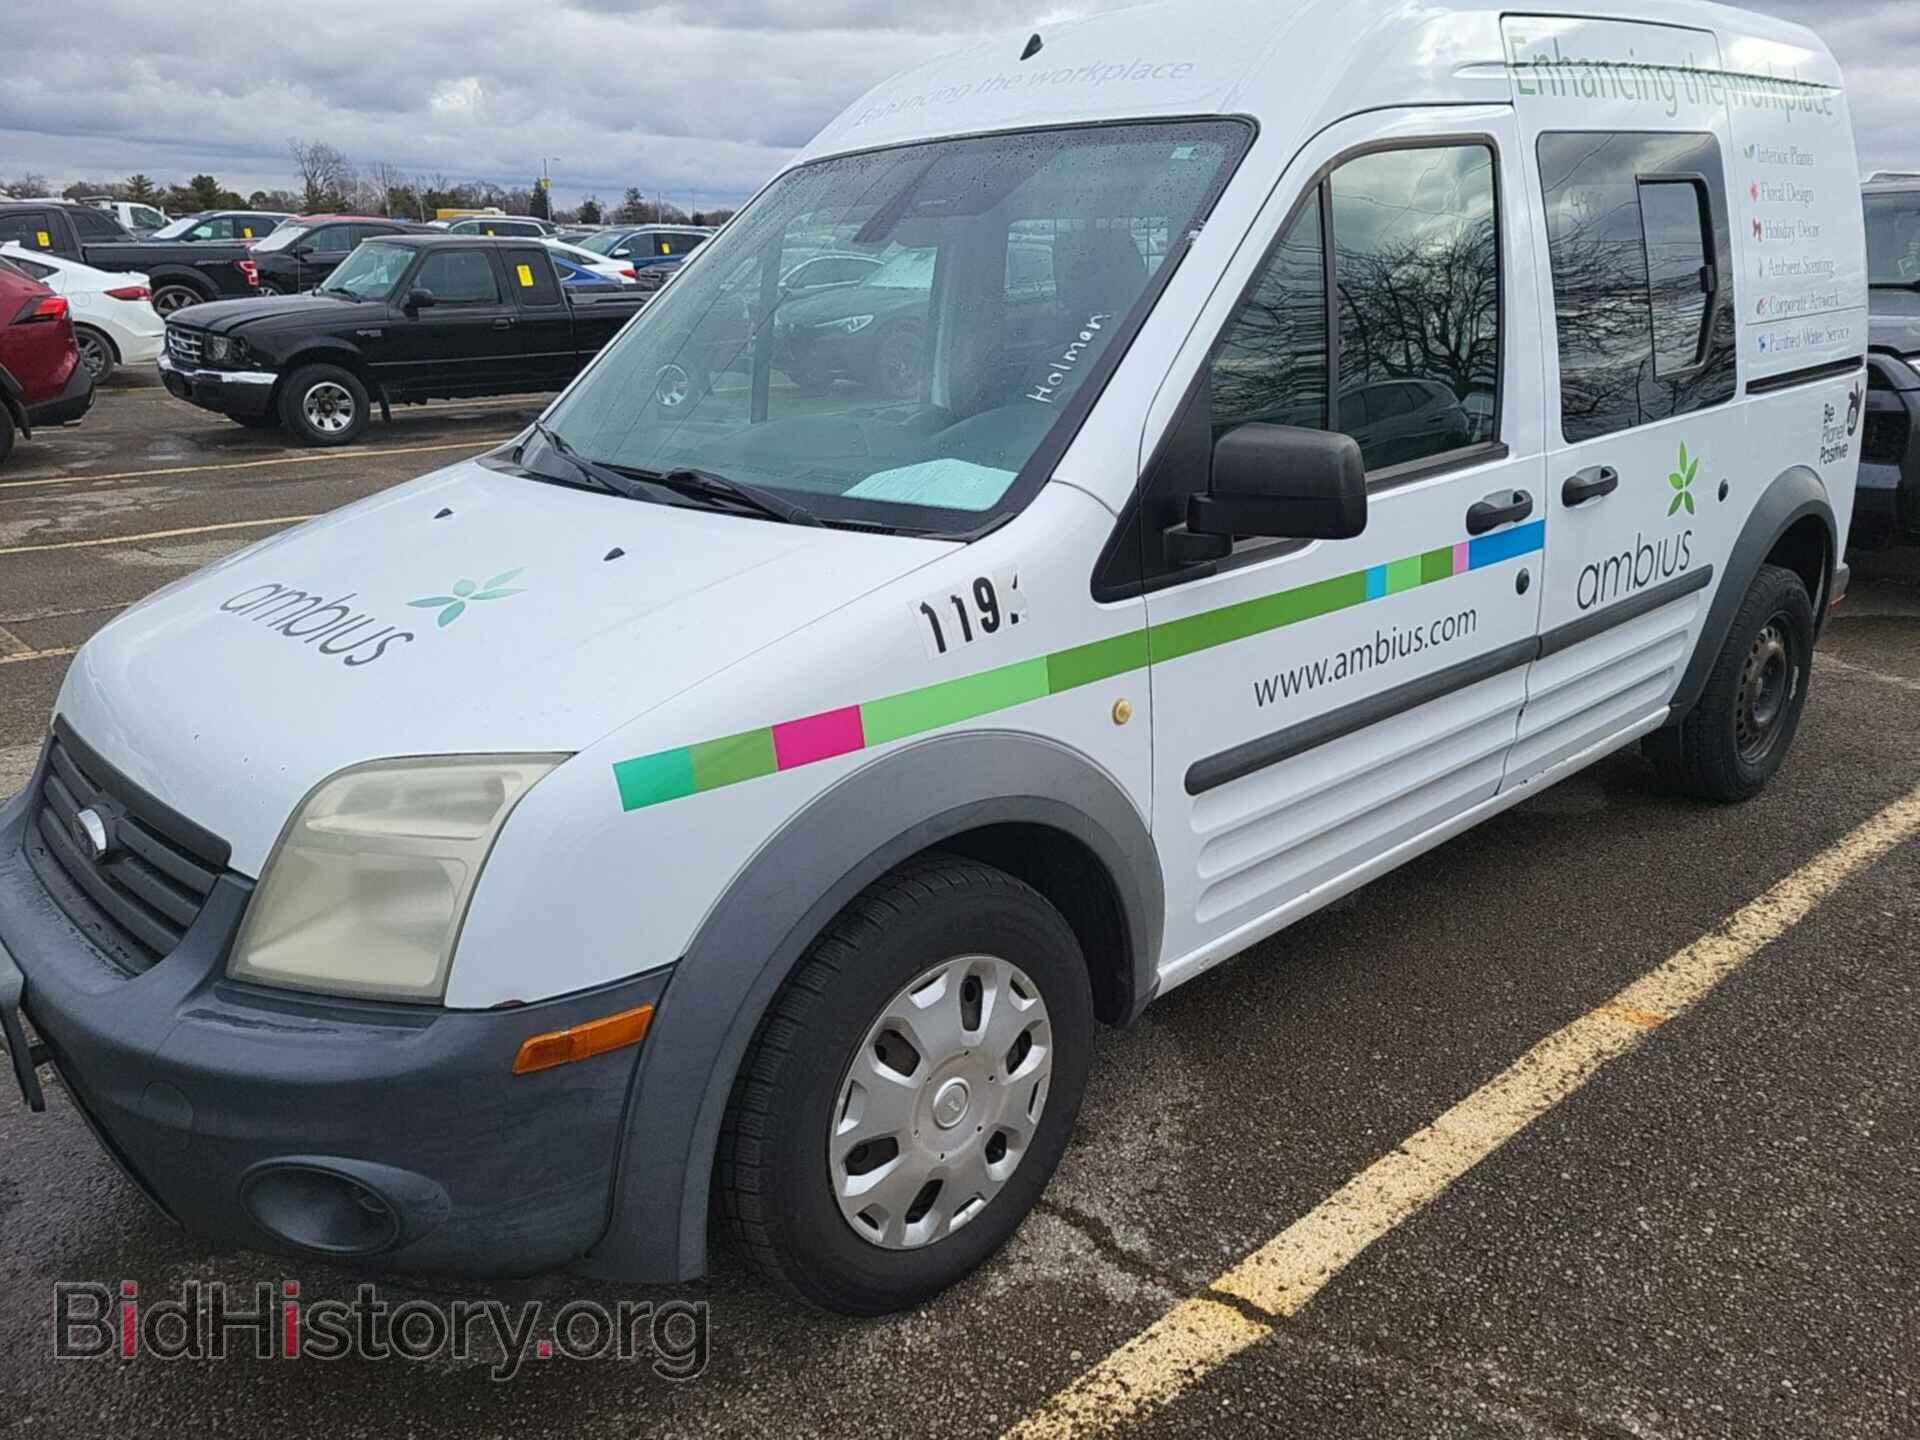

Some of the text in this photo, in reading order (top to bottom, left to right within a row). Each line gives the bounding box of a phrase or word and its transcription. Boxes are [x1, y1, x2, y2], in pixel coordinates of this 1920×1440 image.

[976, 71, 1022, 95] the
[1023, 56, 1195, 88] workplace
[1508, 36, 1678, 117] Enhancing
[1682, 52, 1725, 106] the
[1760, 182, 1815, 208] Floral Design
[1025, 313, 1105, 403] Holman
[1824, 403, 1836, 424] Be
[1820, 443, 1849, 466] Positive
[1577, 530, 1692, 610] ambius
[219, 583, 414, 666] ambius
[1253, 608, 1477, 708] www.ambius.com
